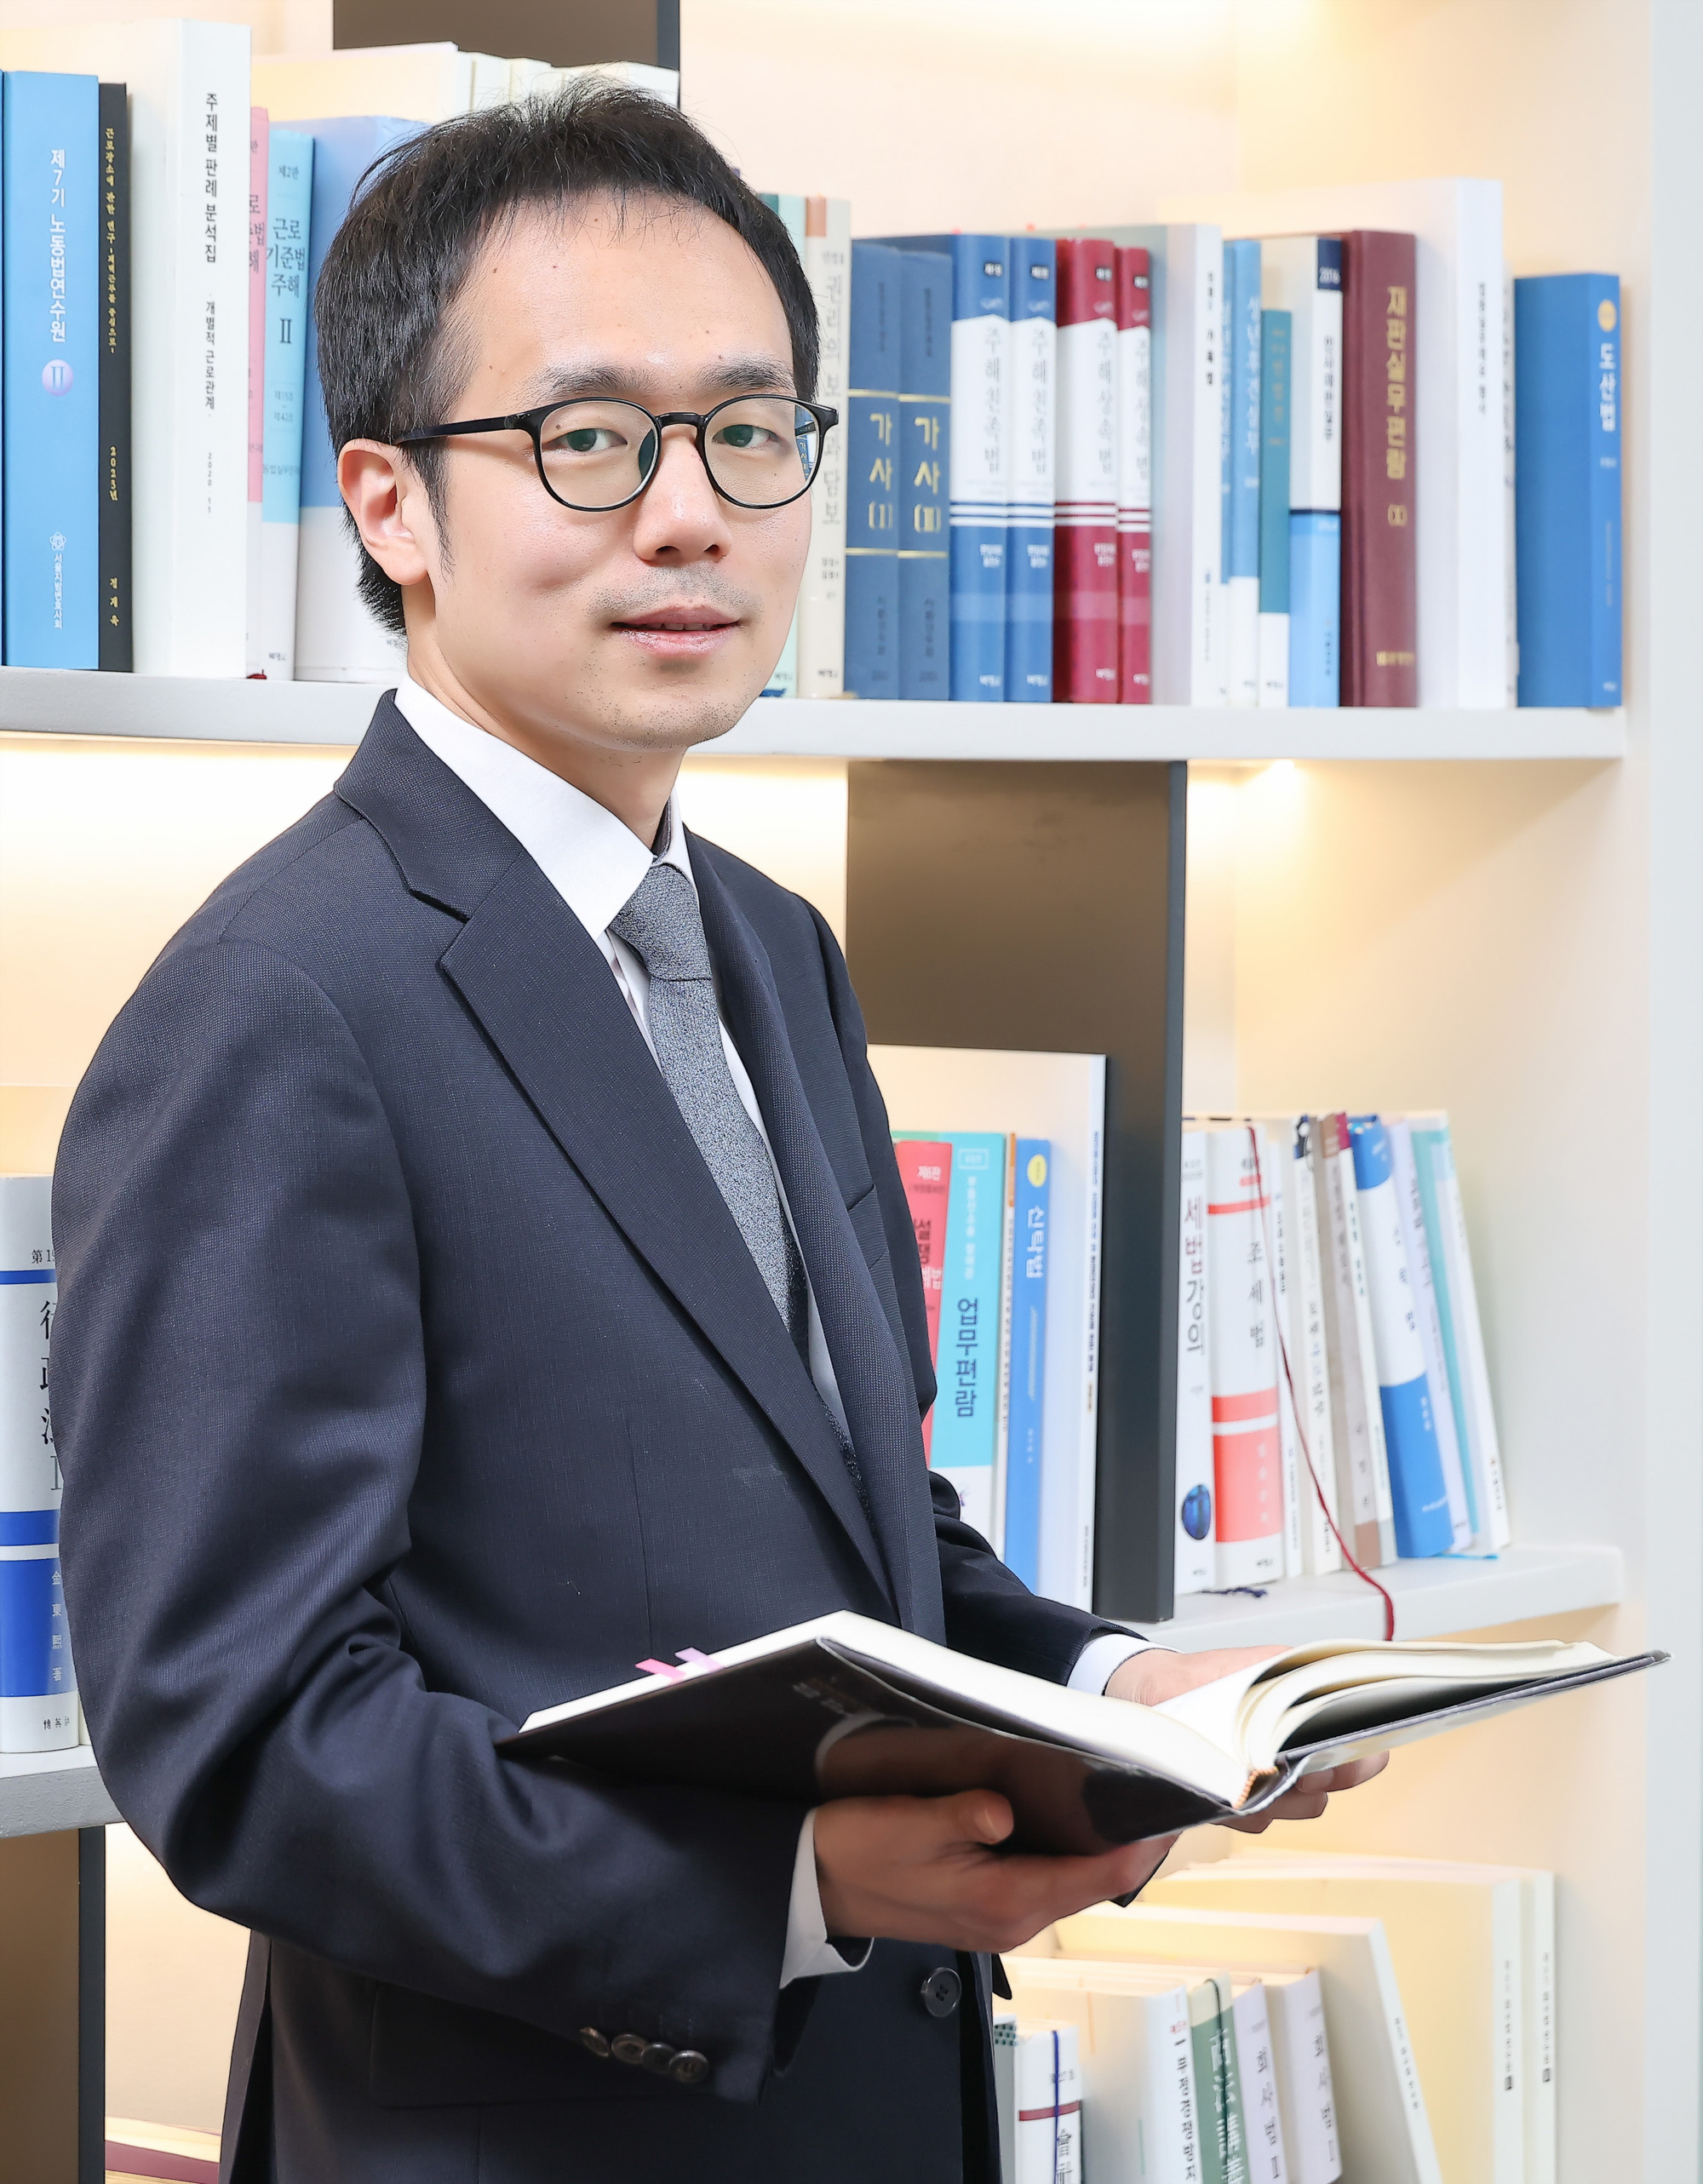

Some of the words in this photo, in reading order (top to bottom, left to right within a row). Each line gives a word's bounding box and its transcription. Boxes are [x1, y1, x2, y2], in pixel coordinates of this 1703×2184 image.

[205, 93, 218, 152] 주제별
[50, 149, 66, 207] 제7기
[205, 159, 218, 198] 판례
[204, 203, 218, 264] 분석집
[267, 244, 306, 272] 기준법
[272, 217, 301, 241] 근로
[49, 214, 66, 342] 노동법연수원
[271, 273, 300, 299] 주해
[205, 301, 215, 346] 개별적
[205, 350, 215, 410] 근로관계
[869, 412, 893, 492] 가사
[914, 416, 941, 496] 가사
[1025, 1204, 1046, 1279] 신탁법
[955, 1298, 978, 1418] 업무편람
